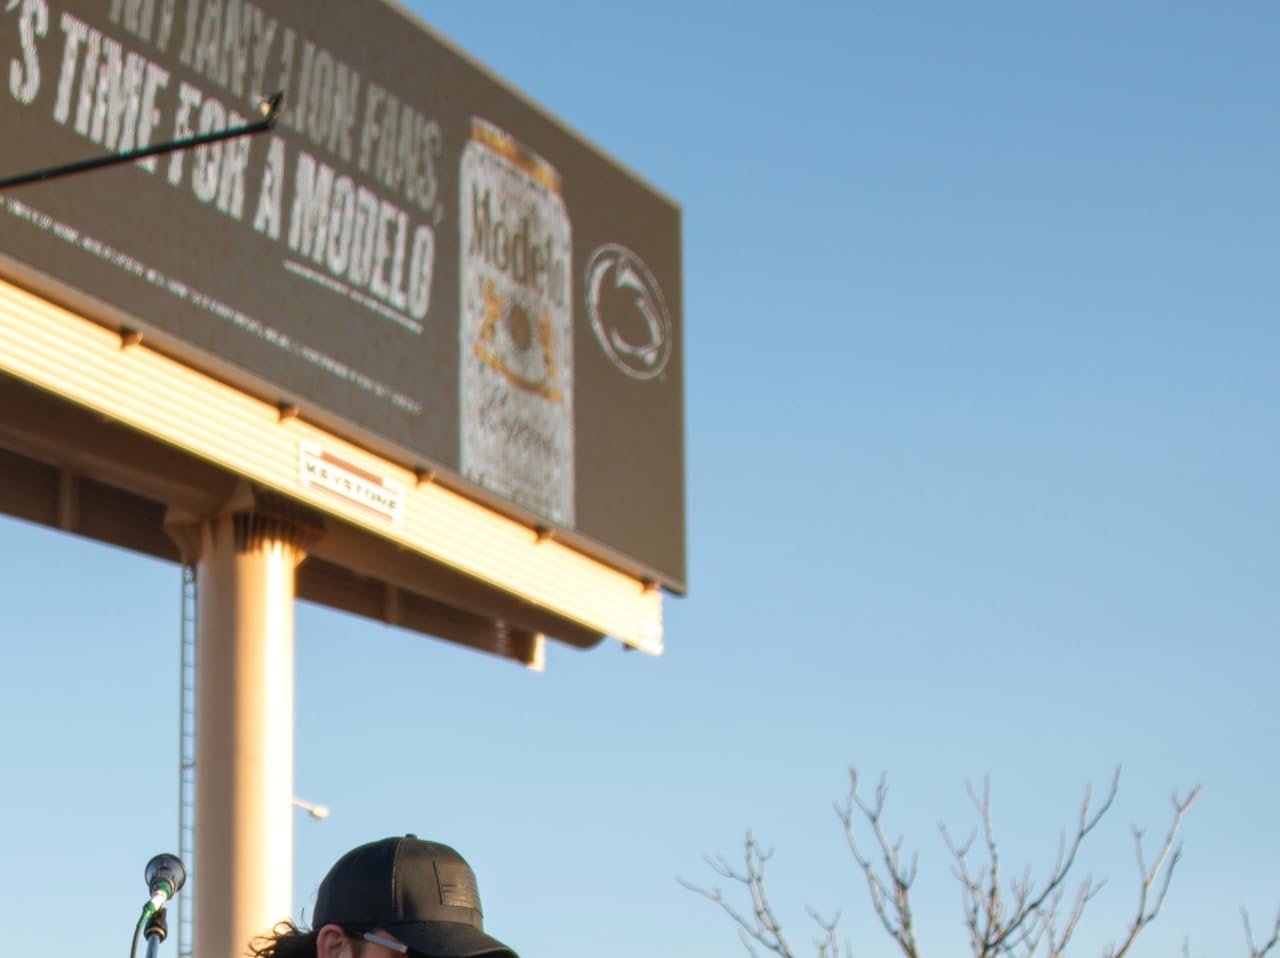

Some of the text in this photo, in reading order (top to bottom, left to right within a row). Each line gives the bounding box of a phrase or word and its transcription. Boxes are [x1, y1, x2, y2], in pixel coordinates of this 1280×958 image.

[53, 11, 170, 175] TIME
[167, 80, 252, 222] FOR
[252, 134, 285, 241] A
[288, 151, 435, 320] MODELO
[108, 0, 278, 112] TANY
[275, 27, 360, 163] LION
